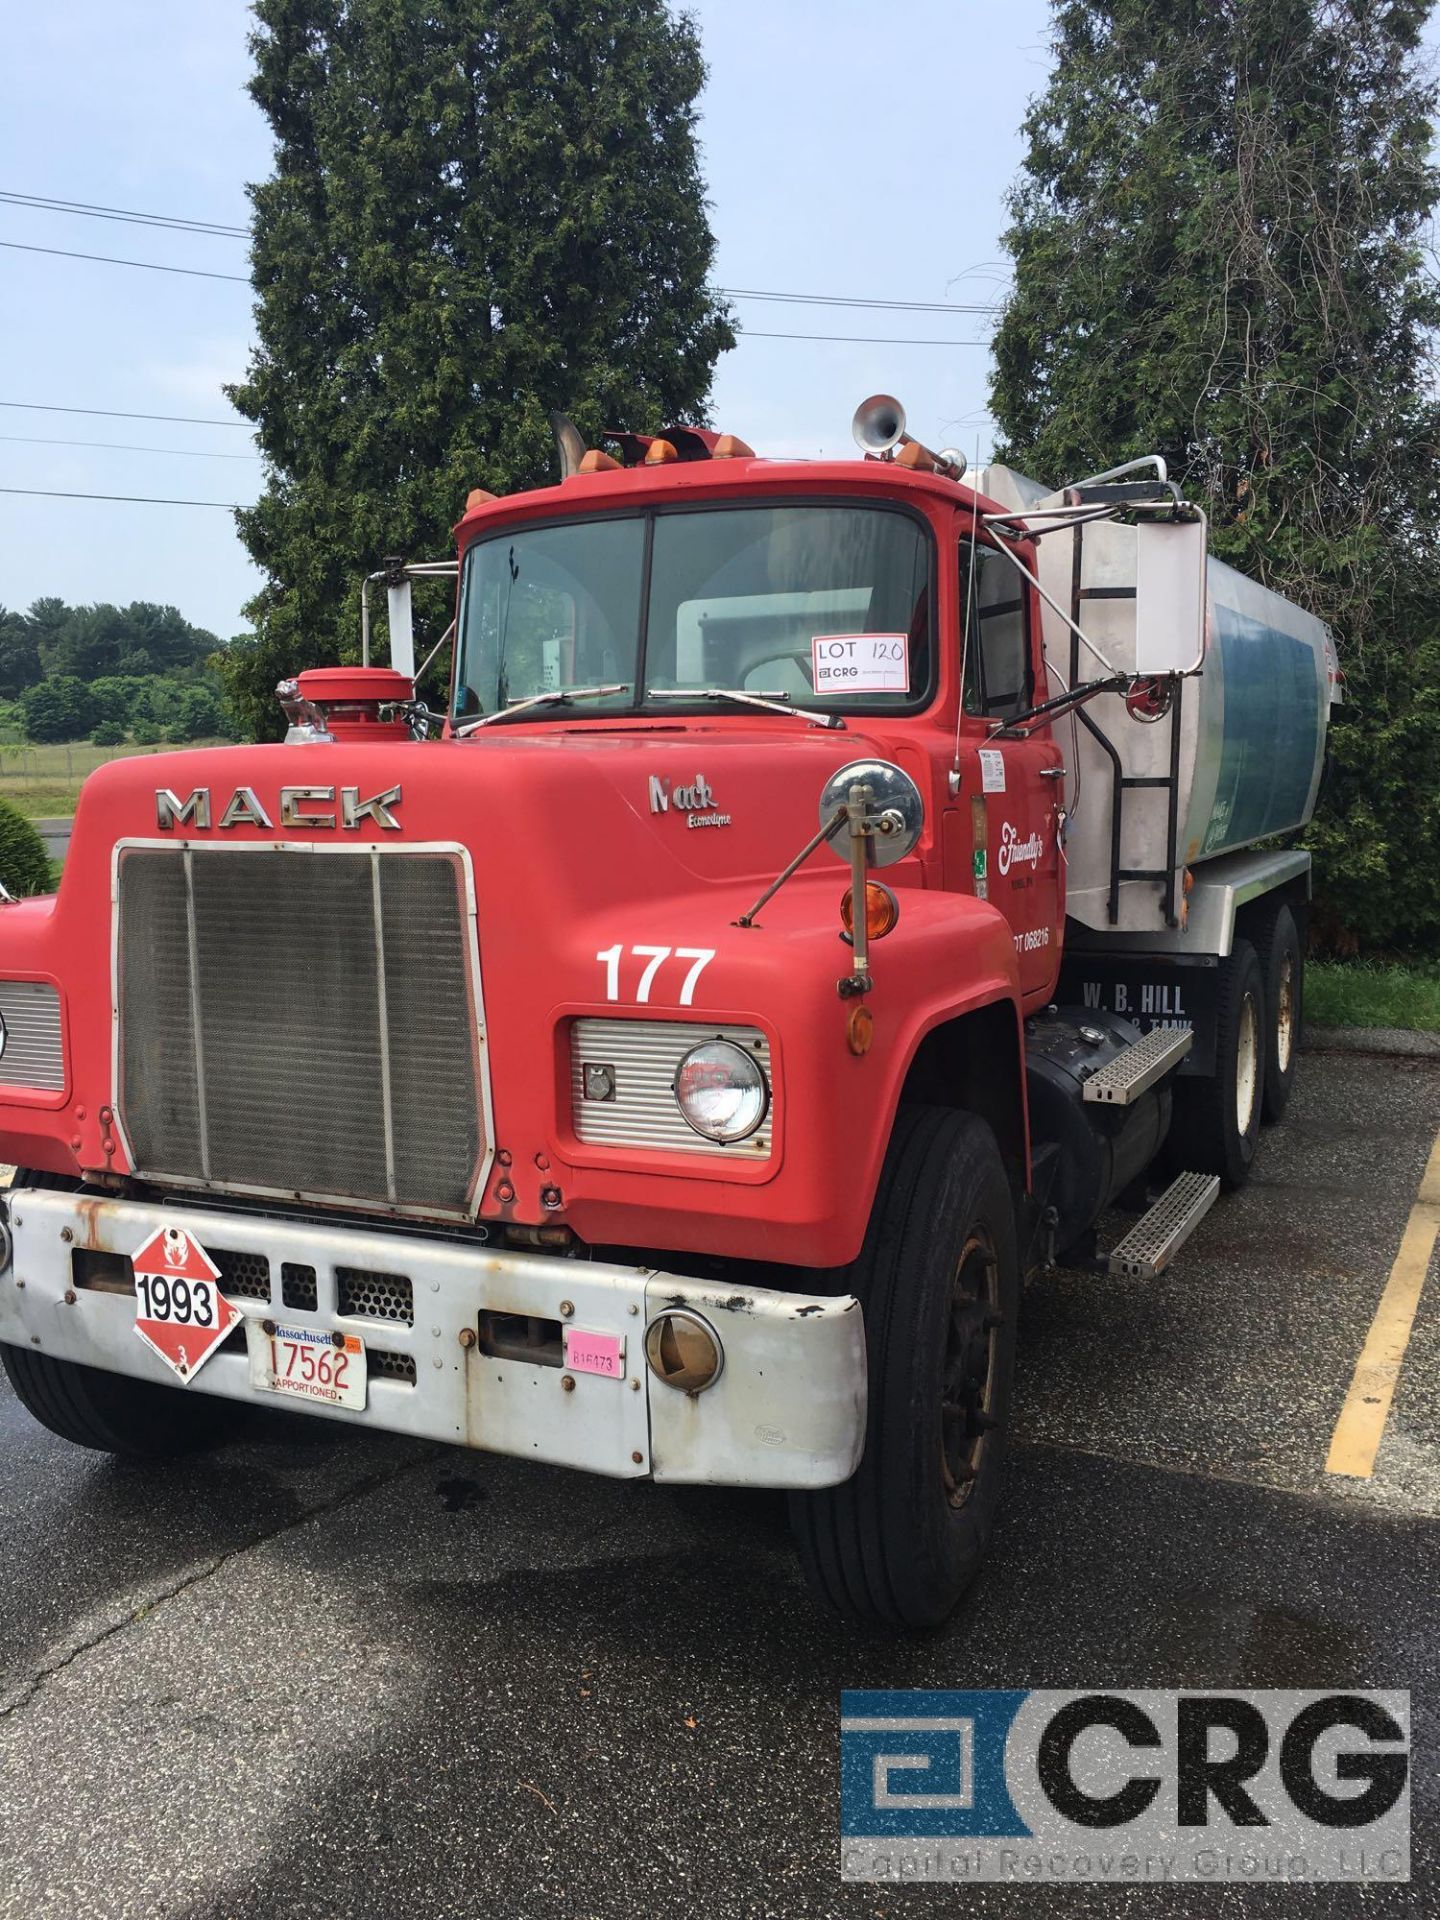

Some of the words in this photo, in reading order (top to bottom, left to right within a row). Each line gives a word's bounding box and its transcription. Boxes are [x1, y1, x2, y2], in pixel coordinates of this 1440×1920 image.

[819, 642, 857, 659] LOT
[872, 642, 904, 661] 120
[833, 666, 858, 678] CRG
[155, 784, 402, 829] MACK
[998, 821, 1043, 876] Friendly's
[1024, 927, 1049, 952] 068216
[596, 944, 716, 1006] 177
[1083, 982, 1108, 1011] W.
[1114, 983, 1133, 1013] B.
[1141, 984, 1186, 1015] HILL
[137, 1274, 213, 1327] 1993
[275, 1325, 334, 1345] assachusett
[177, 1344, 188, 1363] 3
[270, 1340, 349, 1390] 17562
[275, 1377, 337, 1401] APPORTIONED
